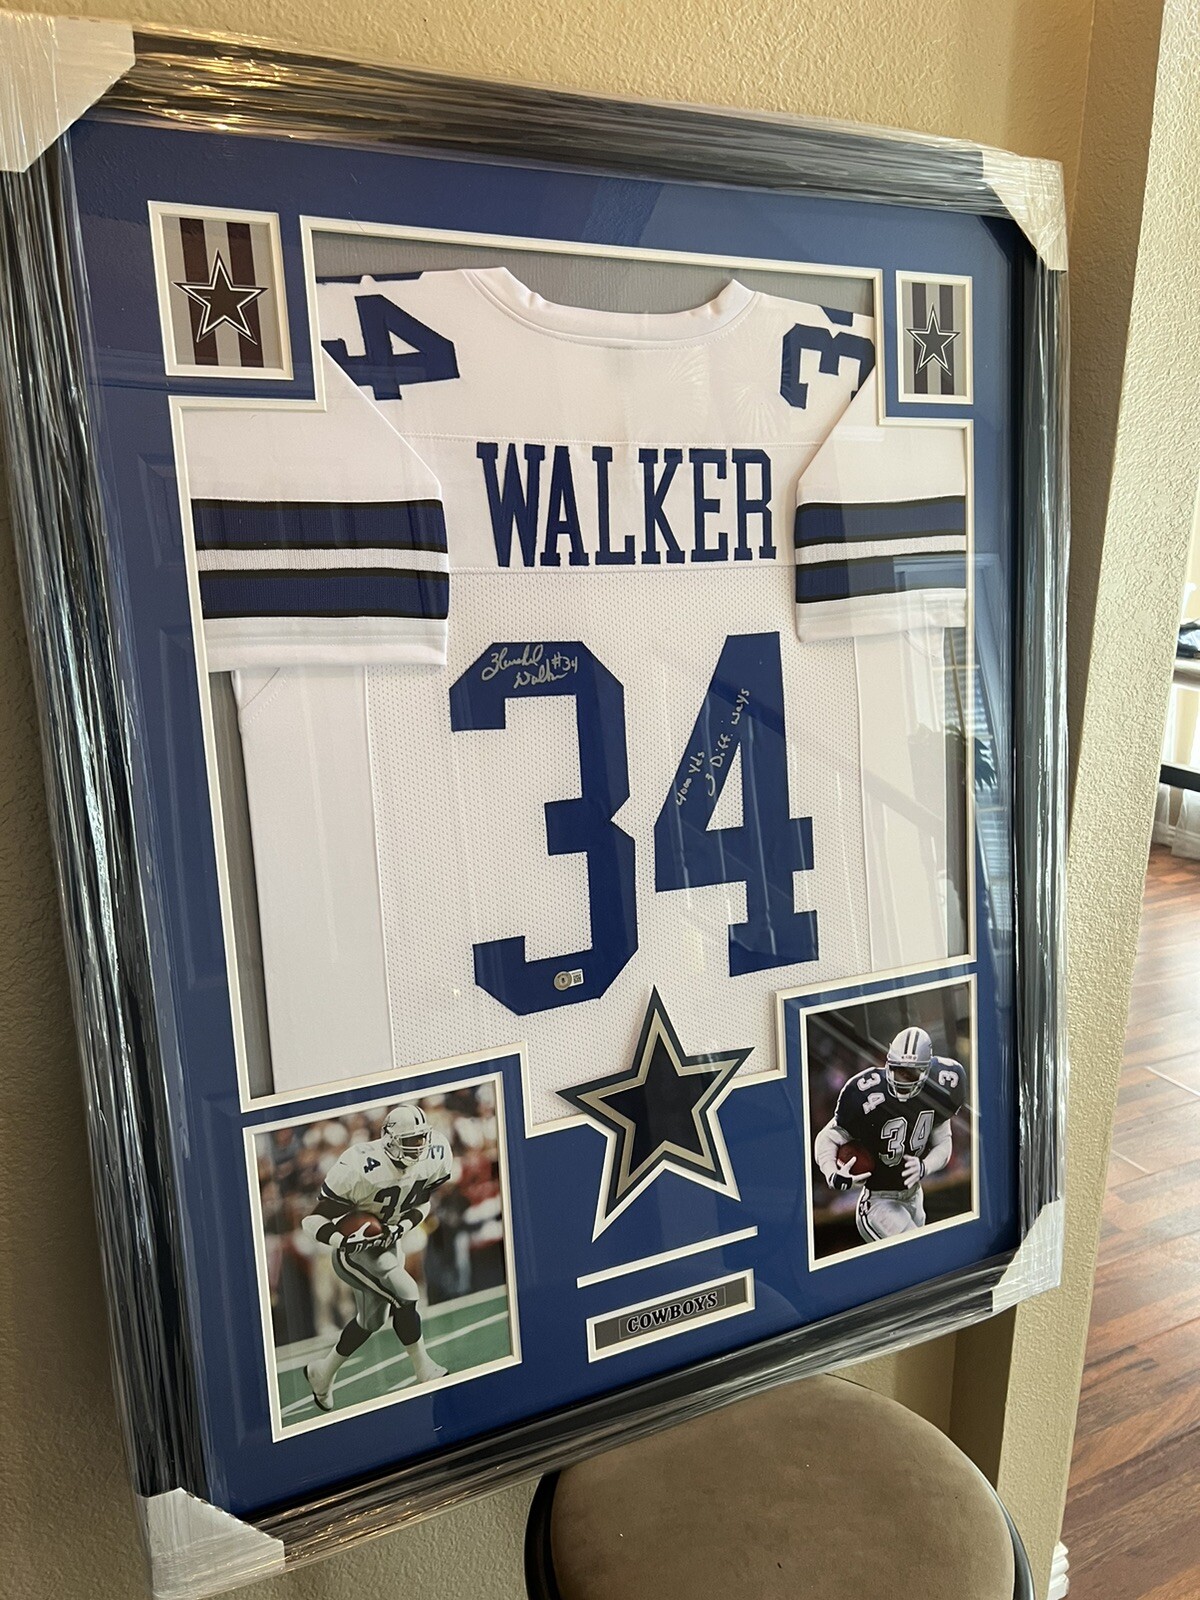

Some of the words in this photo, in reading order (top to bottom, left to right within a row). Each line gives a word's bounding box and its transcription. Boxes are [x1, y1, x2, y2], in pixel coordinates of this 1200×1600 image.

[316, 271, 460, 401] 4
[780, 305, 876, 410] 3
[476, 442, 777, 567] WALKER
[551, 651, 578, 674] #34
[448, 631, 820, 1016] 34
[879, 1109, 936, 1168] 34
[373, 1178, 431, 1225] 34
[627, 1291, 718, 1334] COWBOYS
